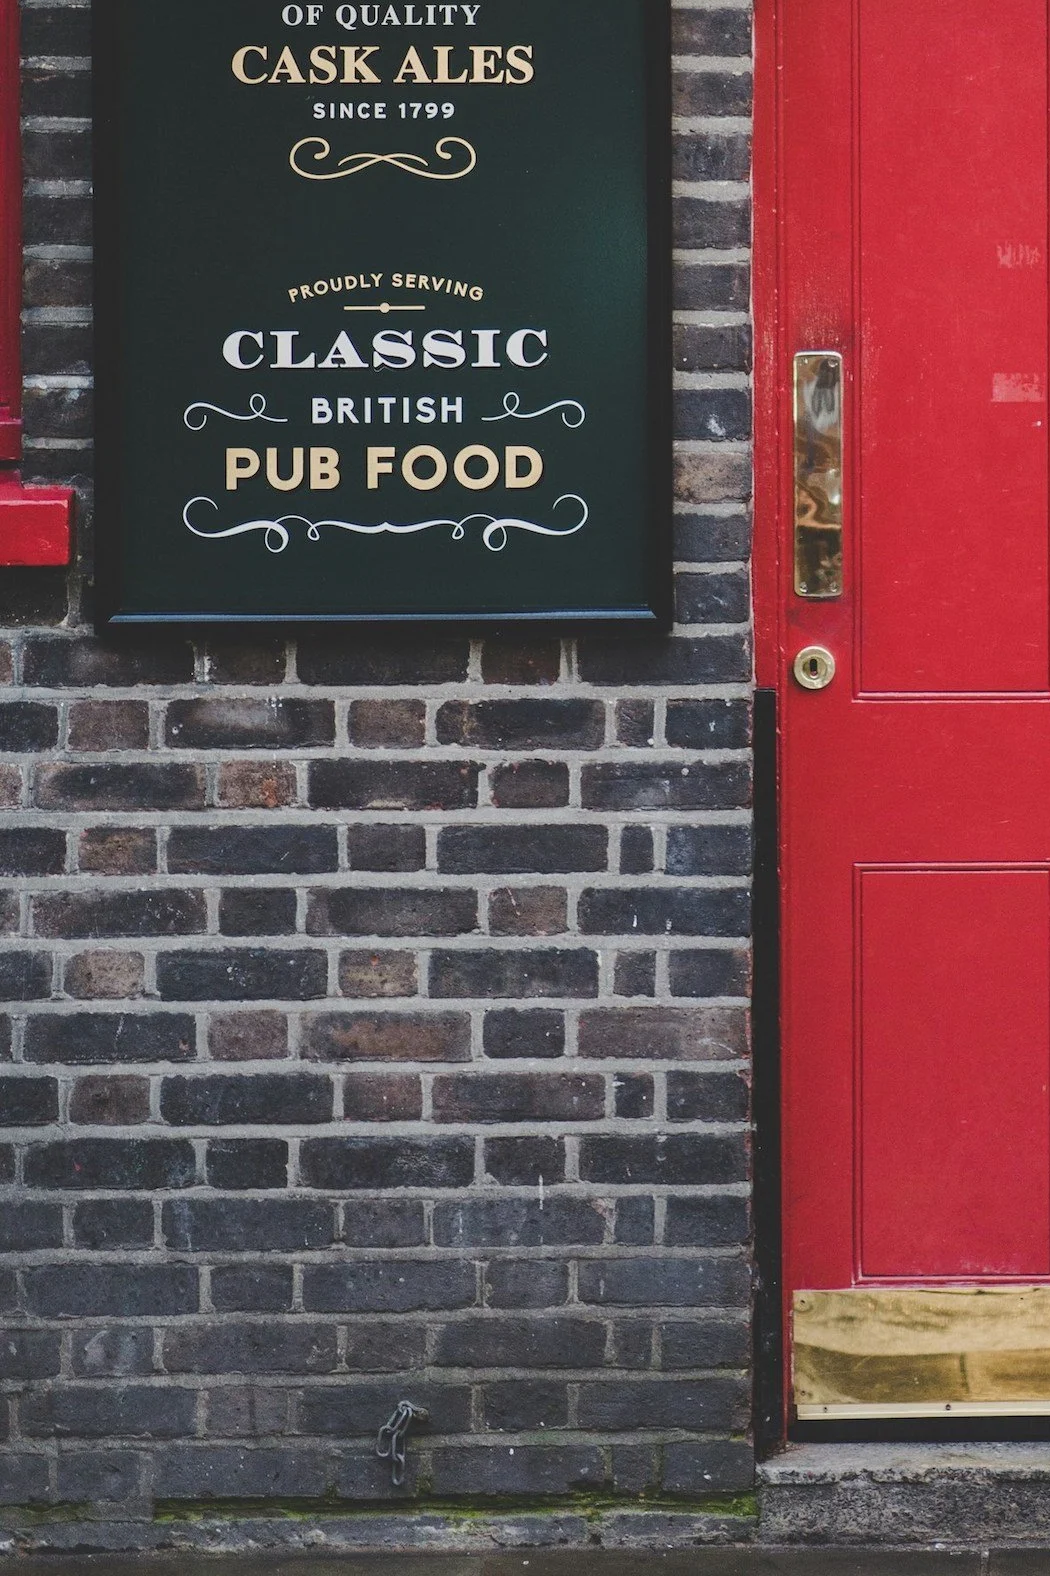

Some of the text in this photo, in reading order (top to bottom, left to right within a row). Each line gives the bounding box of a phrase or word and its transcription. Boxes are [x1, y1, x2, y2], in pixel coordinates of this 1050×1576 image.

[281, 4, 481, 30] OF QUALITY
[231, 45, 535, 85] CASK ALES
[313, 102, 455, 120] SINCE 1799
[288, 272, 484, 303] PROUDLY SERVING
[222, 328, 549, 370] CLASSIC
[311, 396, 463, 424] BRITISH
[225, 444, 544, 491] PUB FOOD
